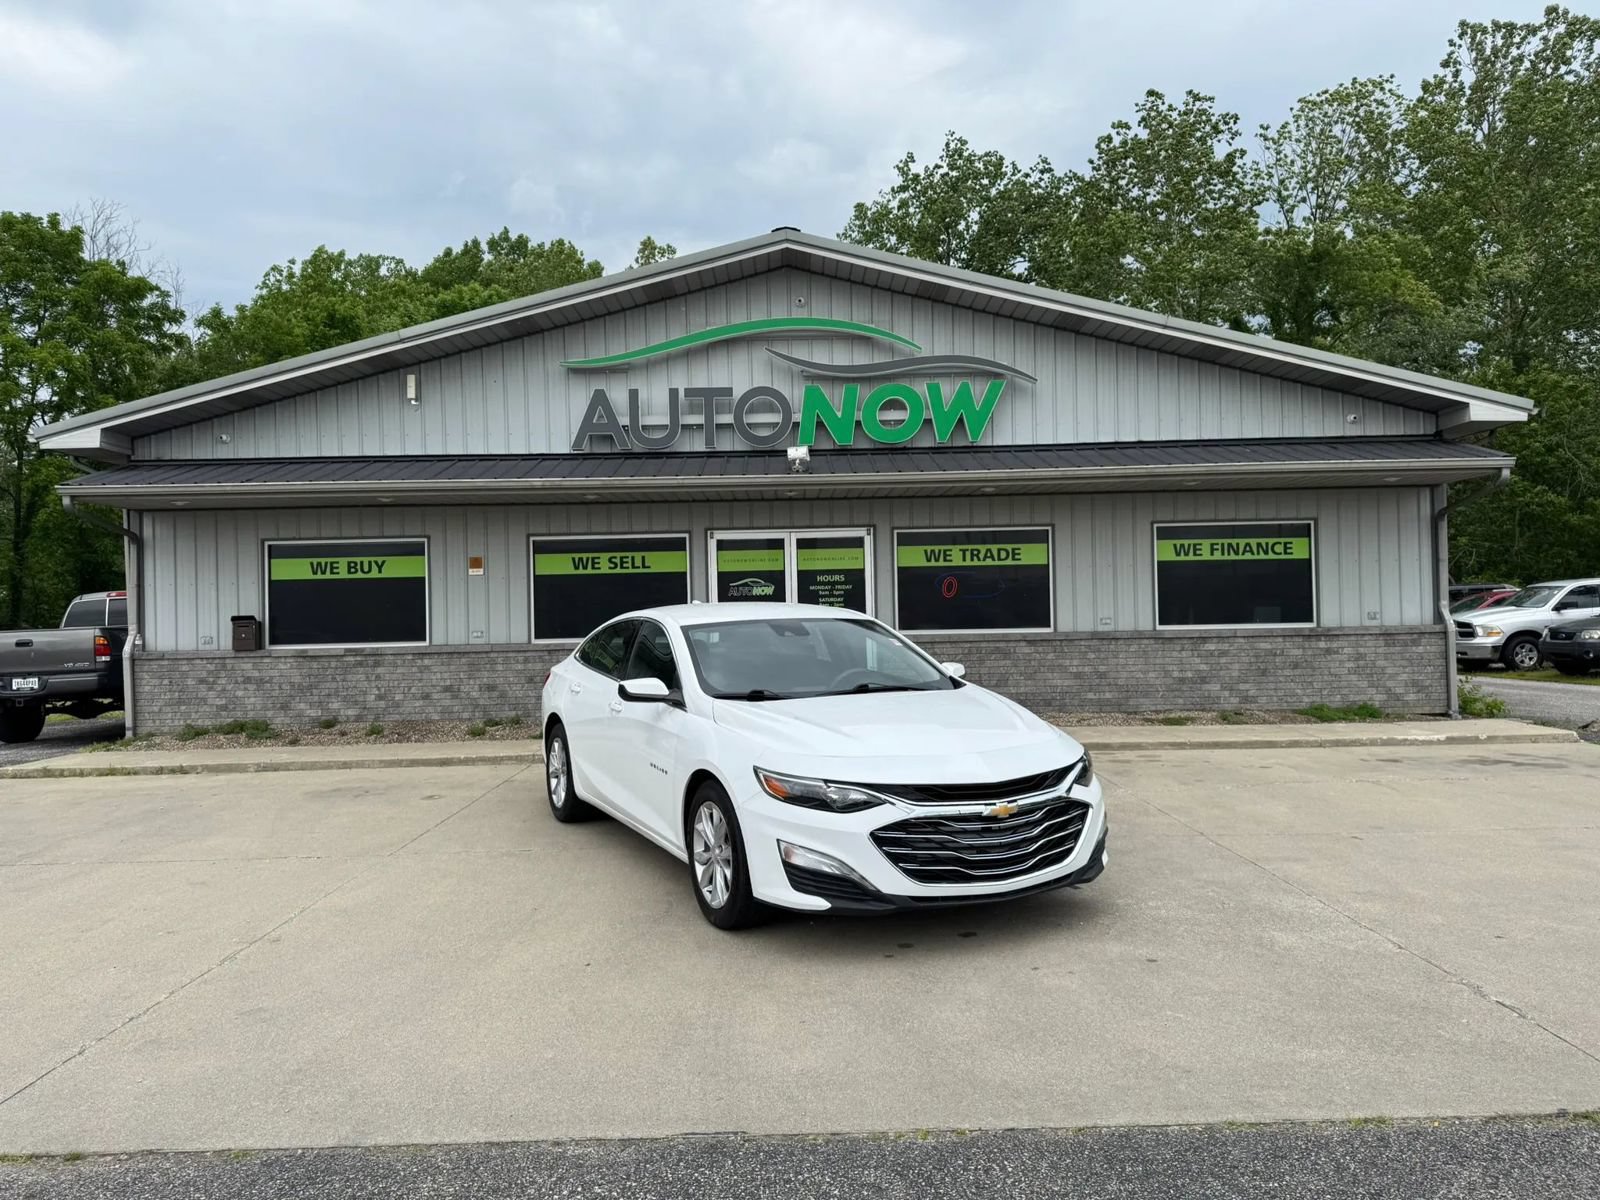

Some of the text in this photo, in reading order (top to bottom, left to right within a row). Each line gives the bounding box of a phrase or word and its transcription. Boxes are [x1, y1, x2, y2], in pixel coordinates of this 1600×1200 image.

[924, 547, 1023, 564] WE TRADE
[1173, 541, 1294, 558] WE FINANCE
[310, 559, 387, 576] WE BUY
[571, 555, 652, 571] WE SELL
[816, 574, 845, 582] HOURS
